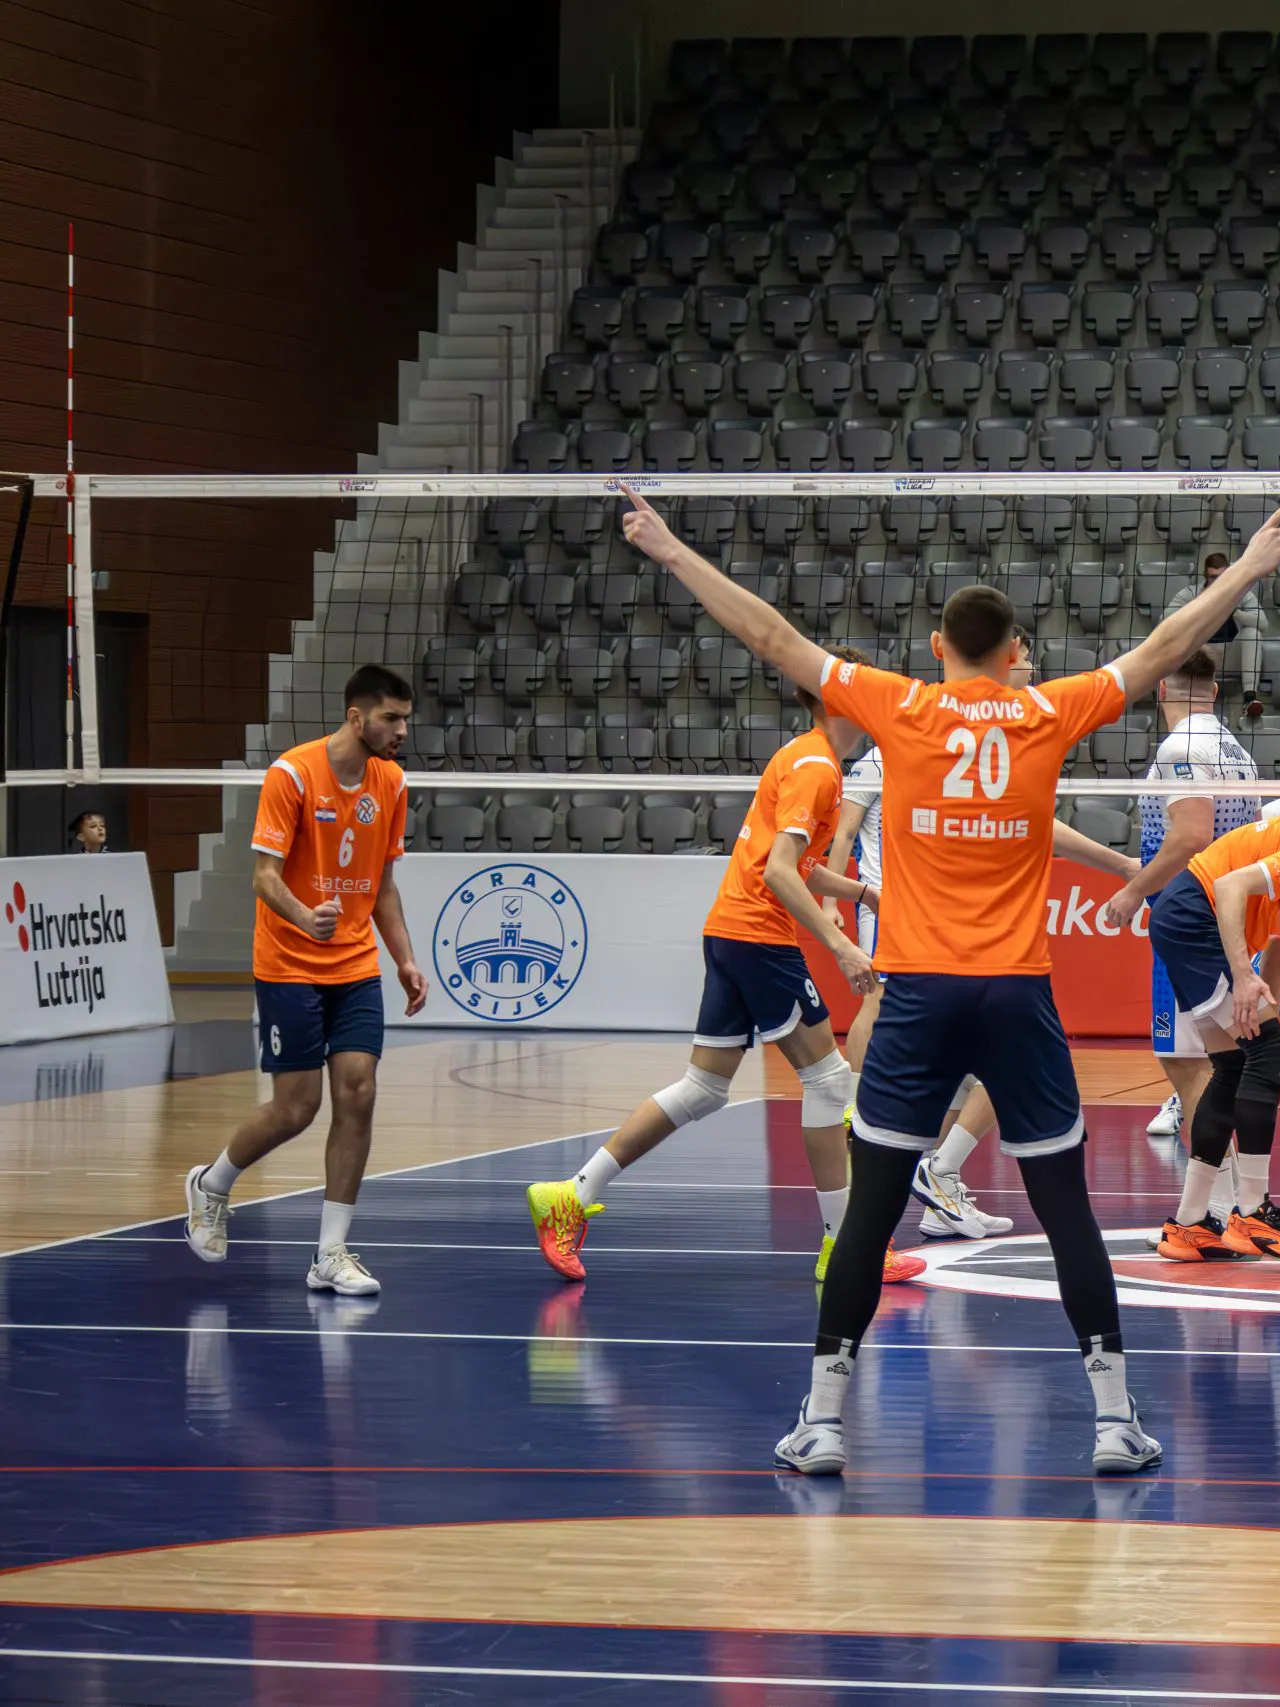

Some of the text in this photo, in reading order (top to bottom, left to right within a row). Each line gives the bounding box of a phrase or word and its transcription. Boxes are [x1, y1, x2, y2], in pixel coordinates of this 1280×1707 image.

[938, 693, 1025, 721] JANKOVIĆ
[942, 726, 1010, 800] 20
[943, 813, 1029, 839] cubus
[338, 827, 355, 868] 6
[459, 872, 566, 905] GRAD
[30, 894, 127, 951] Hrvatska
[34, 956, 106, 1014] Lutrija
[448, 973, 570, 1015] OSIJEK
[804, 978, 820, 1008] 9
[270, 1024, 282, 1057] 6
